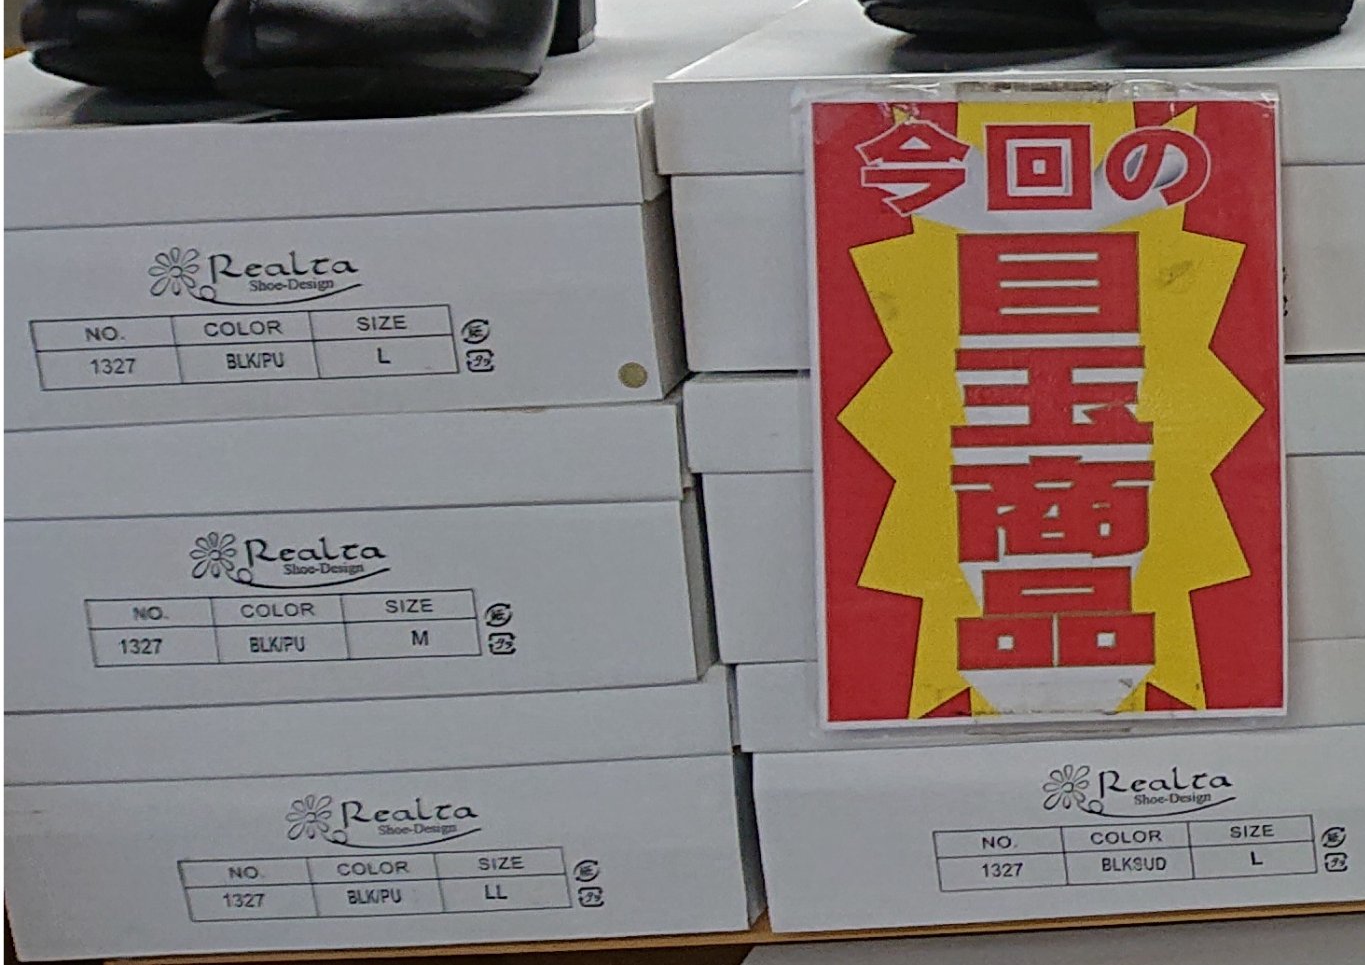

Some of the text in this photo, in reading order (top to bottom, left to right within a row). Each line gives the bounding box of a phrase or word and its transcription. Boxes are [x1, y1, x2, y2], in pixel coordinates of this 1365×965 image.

[855, 119, 1211, 217] 今回の
[207, 249, 360, 285] Realta
[248, 277, 335, 293] Shoe-Design
[203, 319, 284, 338] COLOR
[356, 314, 408, 332] SIZE
[89, 346, 392, 376] 1327 BLK/PU L
[949, 230, 1156, 672] 目玉商品
[243, 536, 388, 569] Realta
[239, 602, 317, 619] COLOR
[384, 597, 435, 614] SIZE
[118, 629, 430, 655] 1327 BLK/PU M
[1098, 766, 1234, 800] Realta
[1133, 791, 1212, 806] Shoe-Design
[340, 796, 480, 830] Realta
[1089, 829, 1163, 846] COLOR
[1229, 823, 1275, 839] SIZE
[336, 855, 526, 877] COLOR SIZE
[981, 861, 1024, 878] 1327
[1249, 850, 1264, 866] L
[222, 892, 266, 909] 1327
[484, 883, 509, 900] LL
